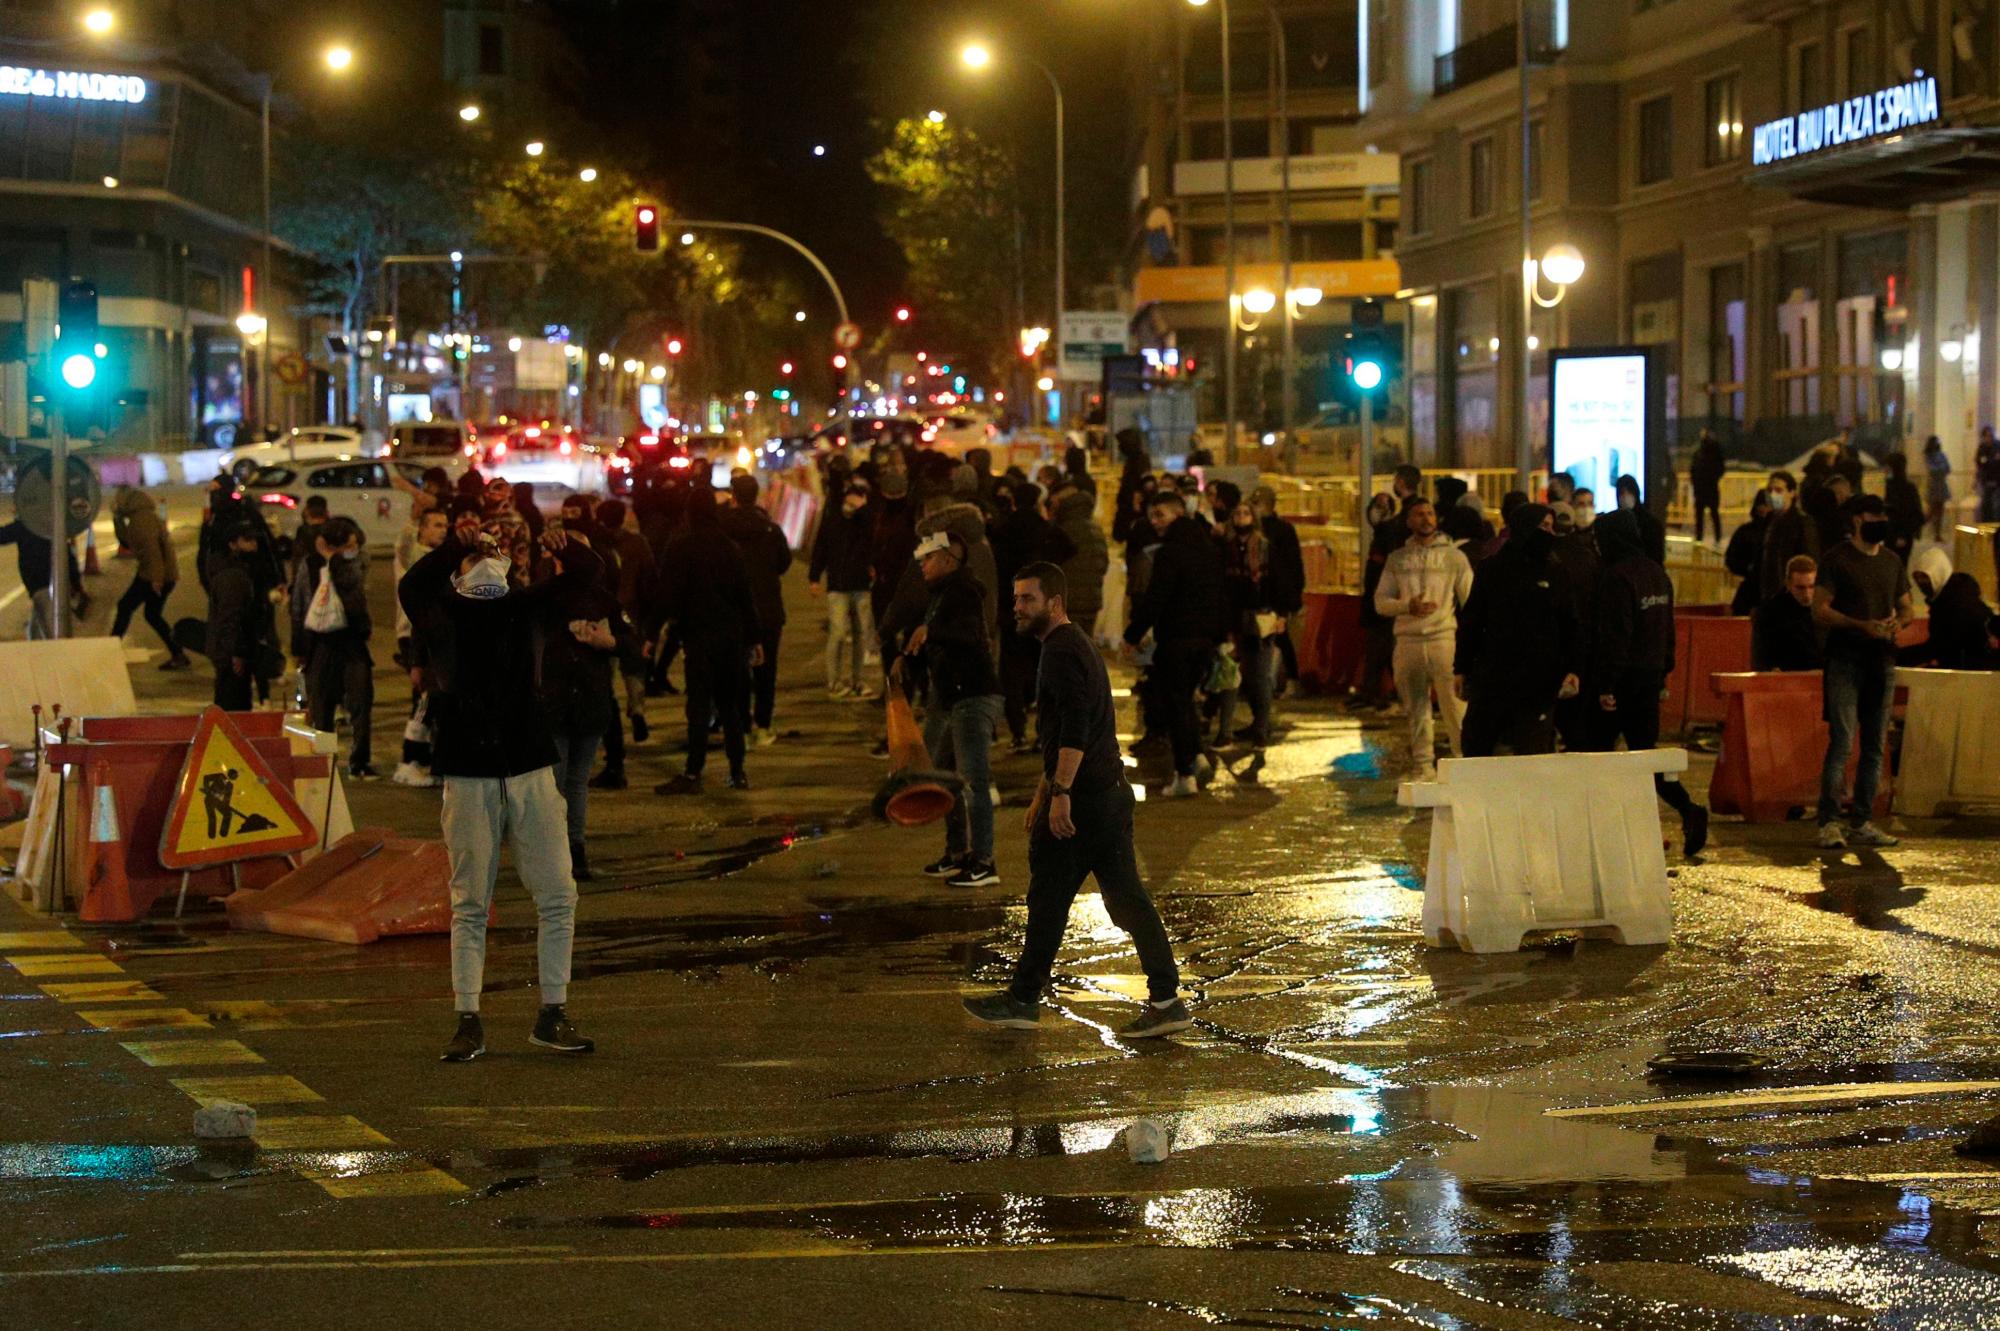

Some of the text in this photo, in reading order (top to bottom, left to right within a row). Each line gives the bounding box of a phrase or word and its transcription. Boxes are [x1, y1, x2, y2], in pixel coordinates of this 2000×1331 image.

[56, 71, 146, 103] MADRID
[1753, 68, 1939, 165] HOTEL RIU PLAZA ESPAÑA
